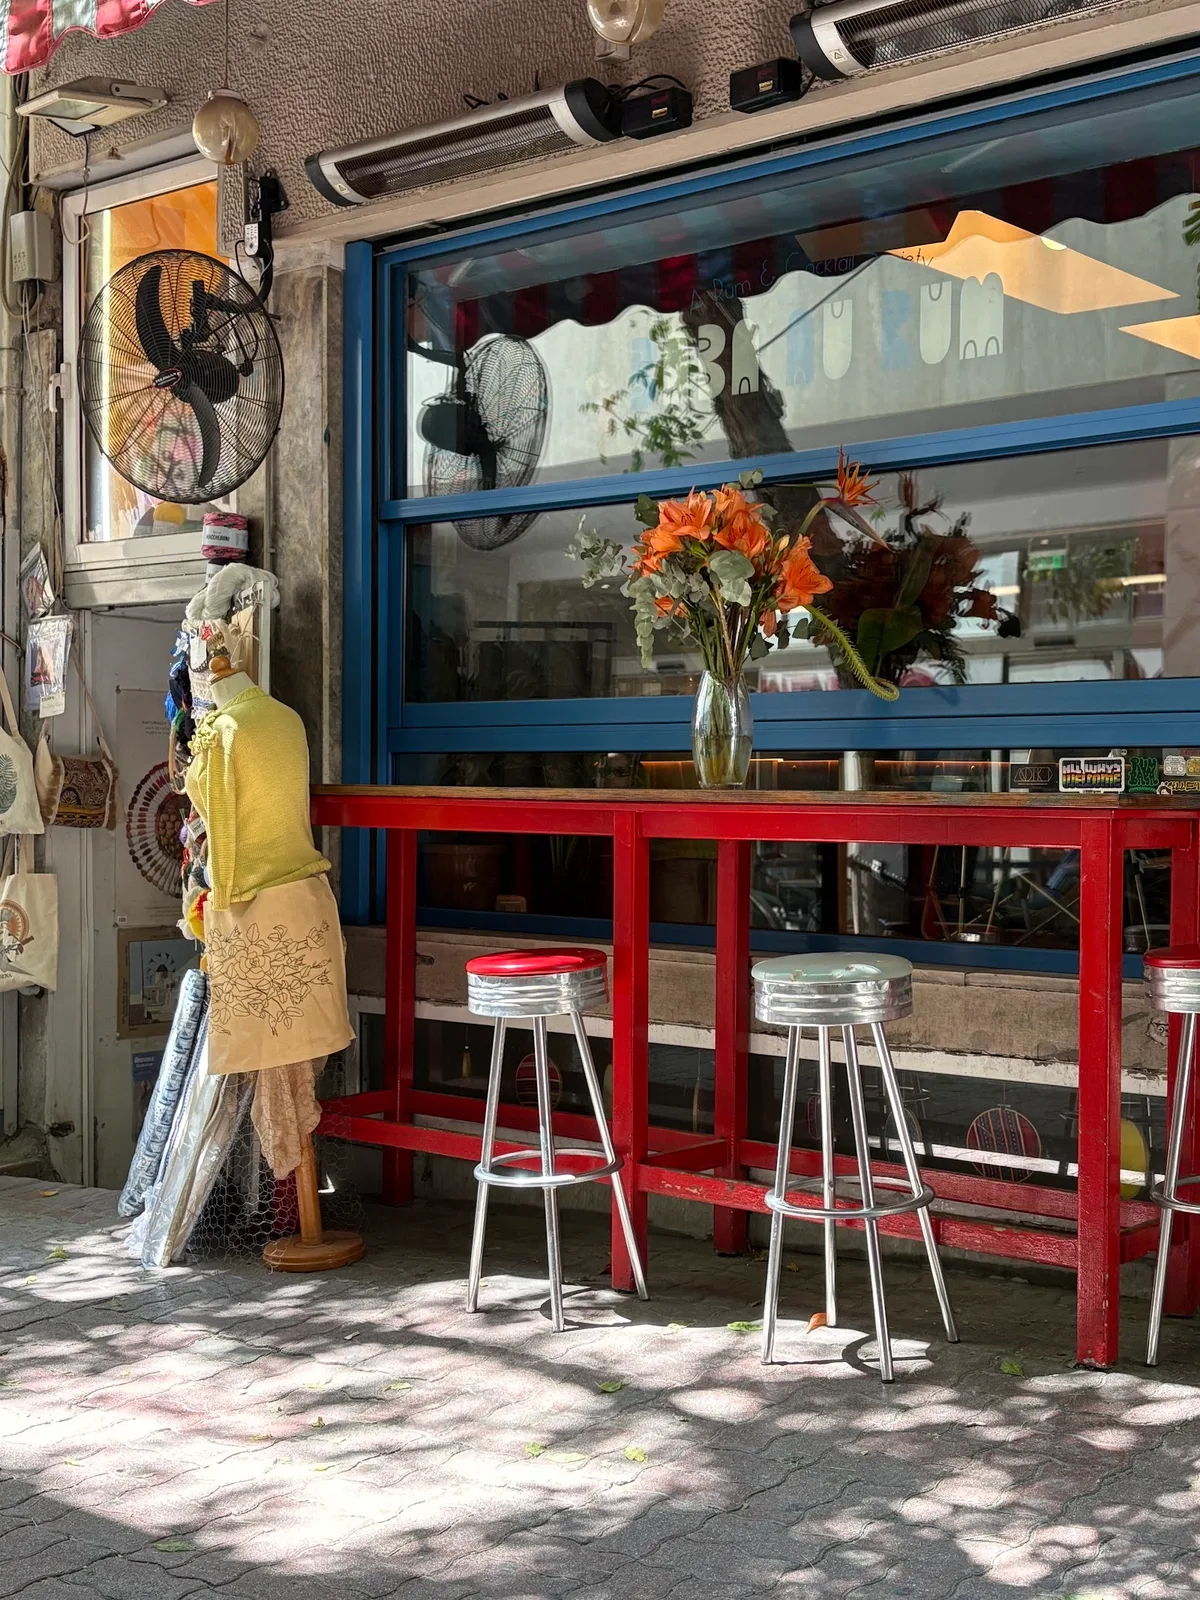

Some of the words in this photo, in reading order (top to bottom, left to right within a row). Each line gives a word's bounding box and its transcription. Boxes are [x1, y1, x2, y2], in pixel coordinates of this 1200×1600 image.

[689, 287, 705, 316] A
[712, 277, 752, 300] Rum
[785, 252, 856, 275] Cocktail
[880, 271, 1004, 373] RUM
